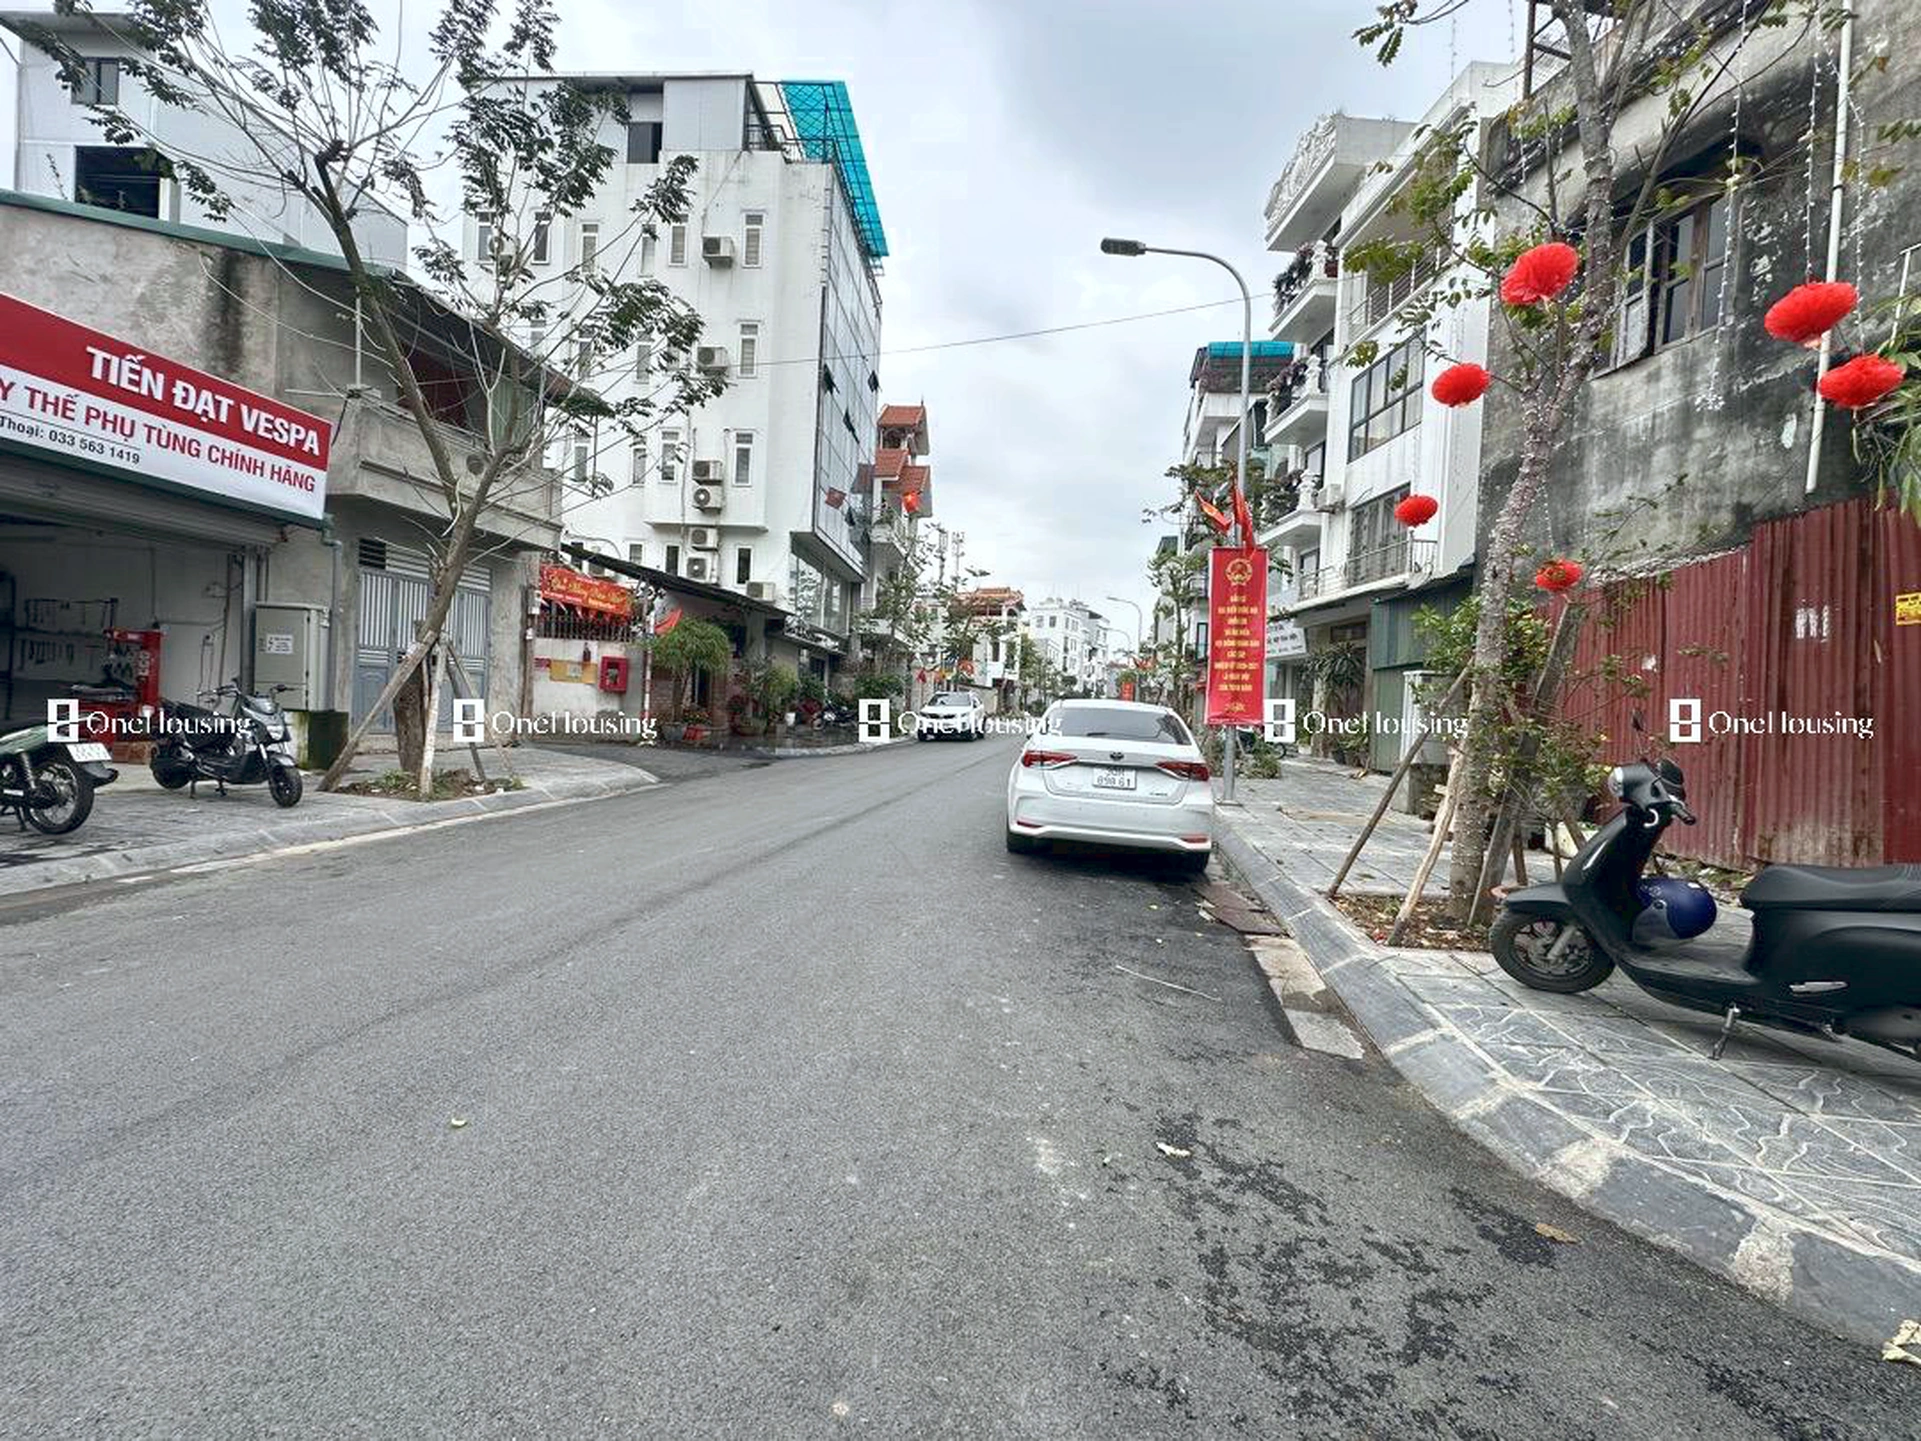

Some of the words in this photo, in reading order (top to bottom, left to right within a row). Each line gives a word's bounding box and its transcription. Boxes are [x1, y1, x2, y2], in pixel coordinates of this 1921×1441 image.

[24, 385, 79, 422] THẾ
[84, 406, 136, 443] PHỤ
[142, 422, 201, 458] TÙNG
[207, 445, 264, 478] CHÍNH
[269, 464, 315, 493] HÀNG
[48, 429, 76, 447] 033
[79, 438, 105, 455] 563
[110, 449, 140, 465] 1419
[86, 346, 164, 400] TIẾN
[172, 380, 234, 424] ĐẠT
[239, 404, 320, 456] VESPA
